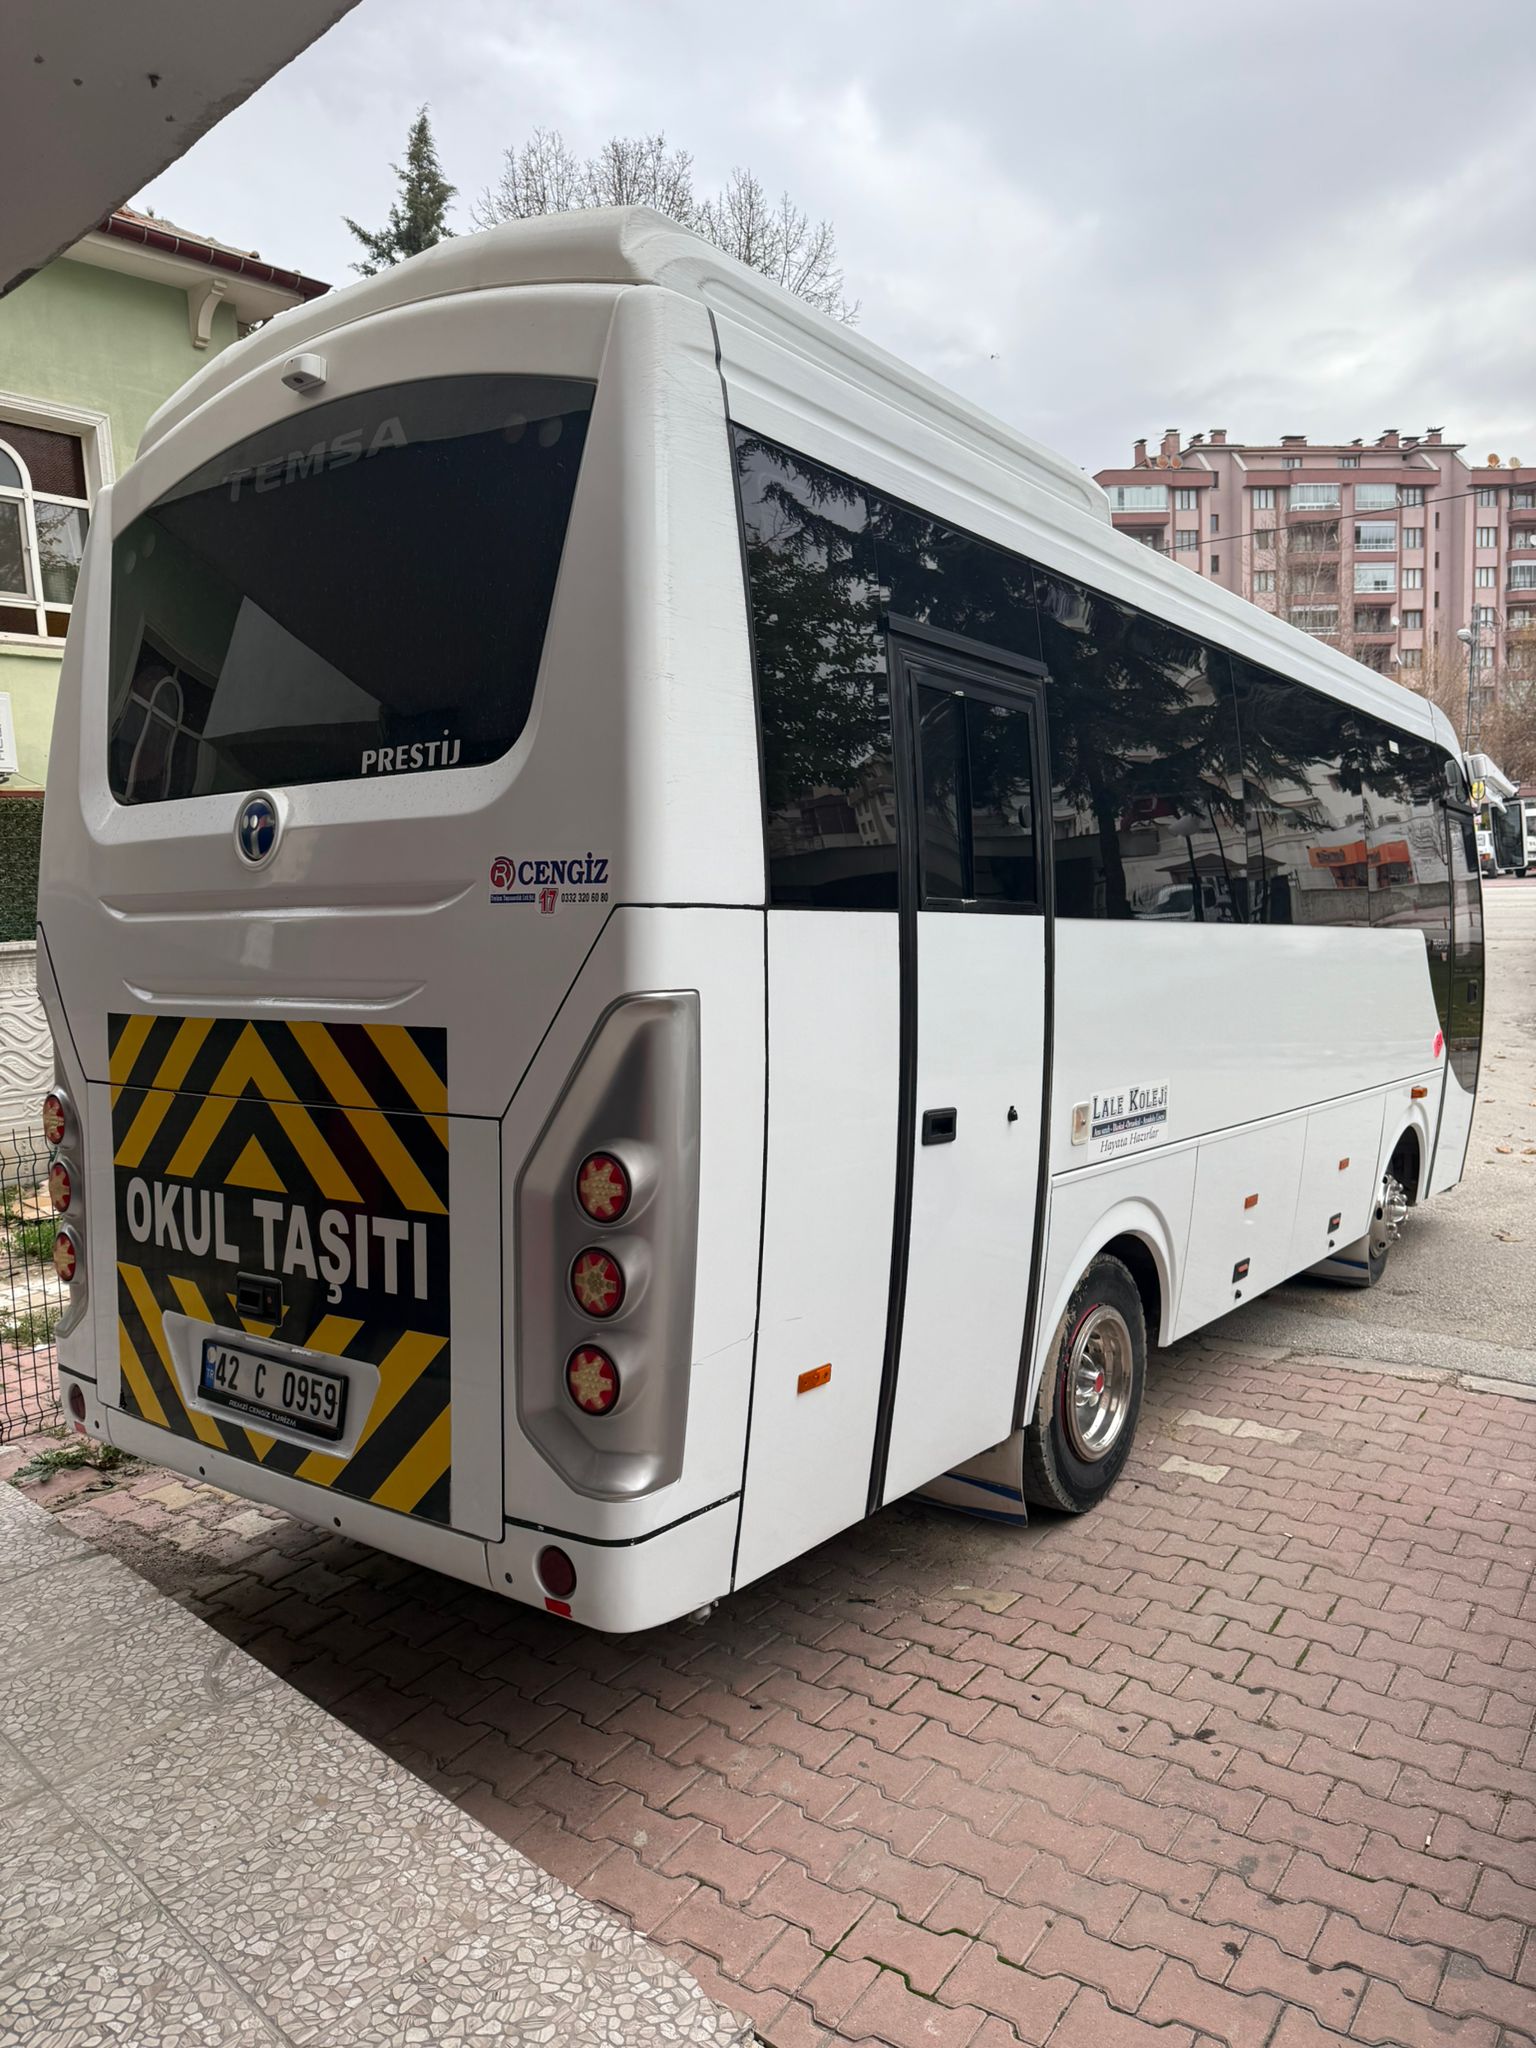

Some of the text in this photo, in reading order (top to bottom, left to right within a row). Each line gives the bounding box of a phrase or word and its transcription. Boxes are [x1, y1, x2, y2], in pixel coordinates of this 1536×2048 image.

[222, 416, 408, 502] TEMSA
[361, 729, 461, 774] PRESTİJ
[518, 852, 609, 885] CENGİZ
[539, 888, 559, 914] 17
[561, 892, 576, 903] 0332
[578, 892, 590, 903] 320
[1092, 1095, 1125, 1120] LALE
[1100, 1137, 1128, 1156] Hayata
[126, 1176, 428, 1304] OKUL TAŞITI
[206, 1367, 214, 1379] TR
[215, 1352, 337, 1420] 42 C 0959
